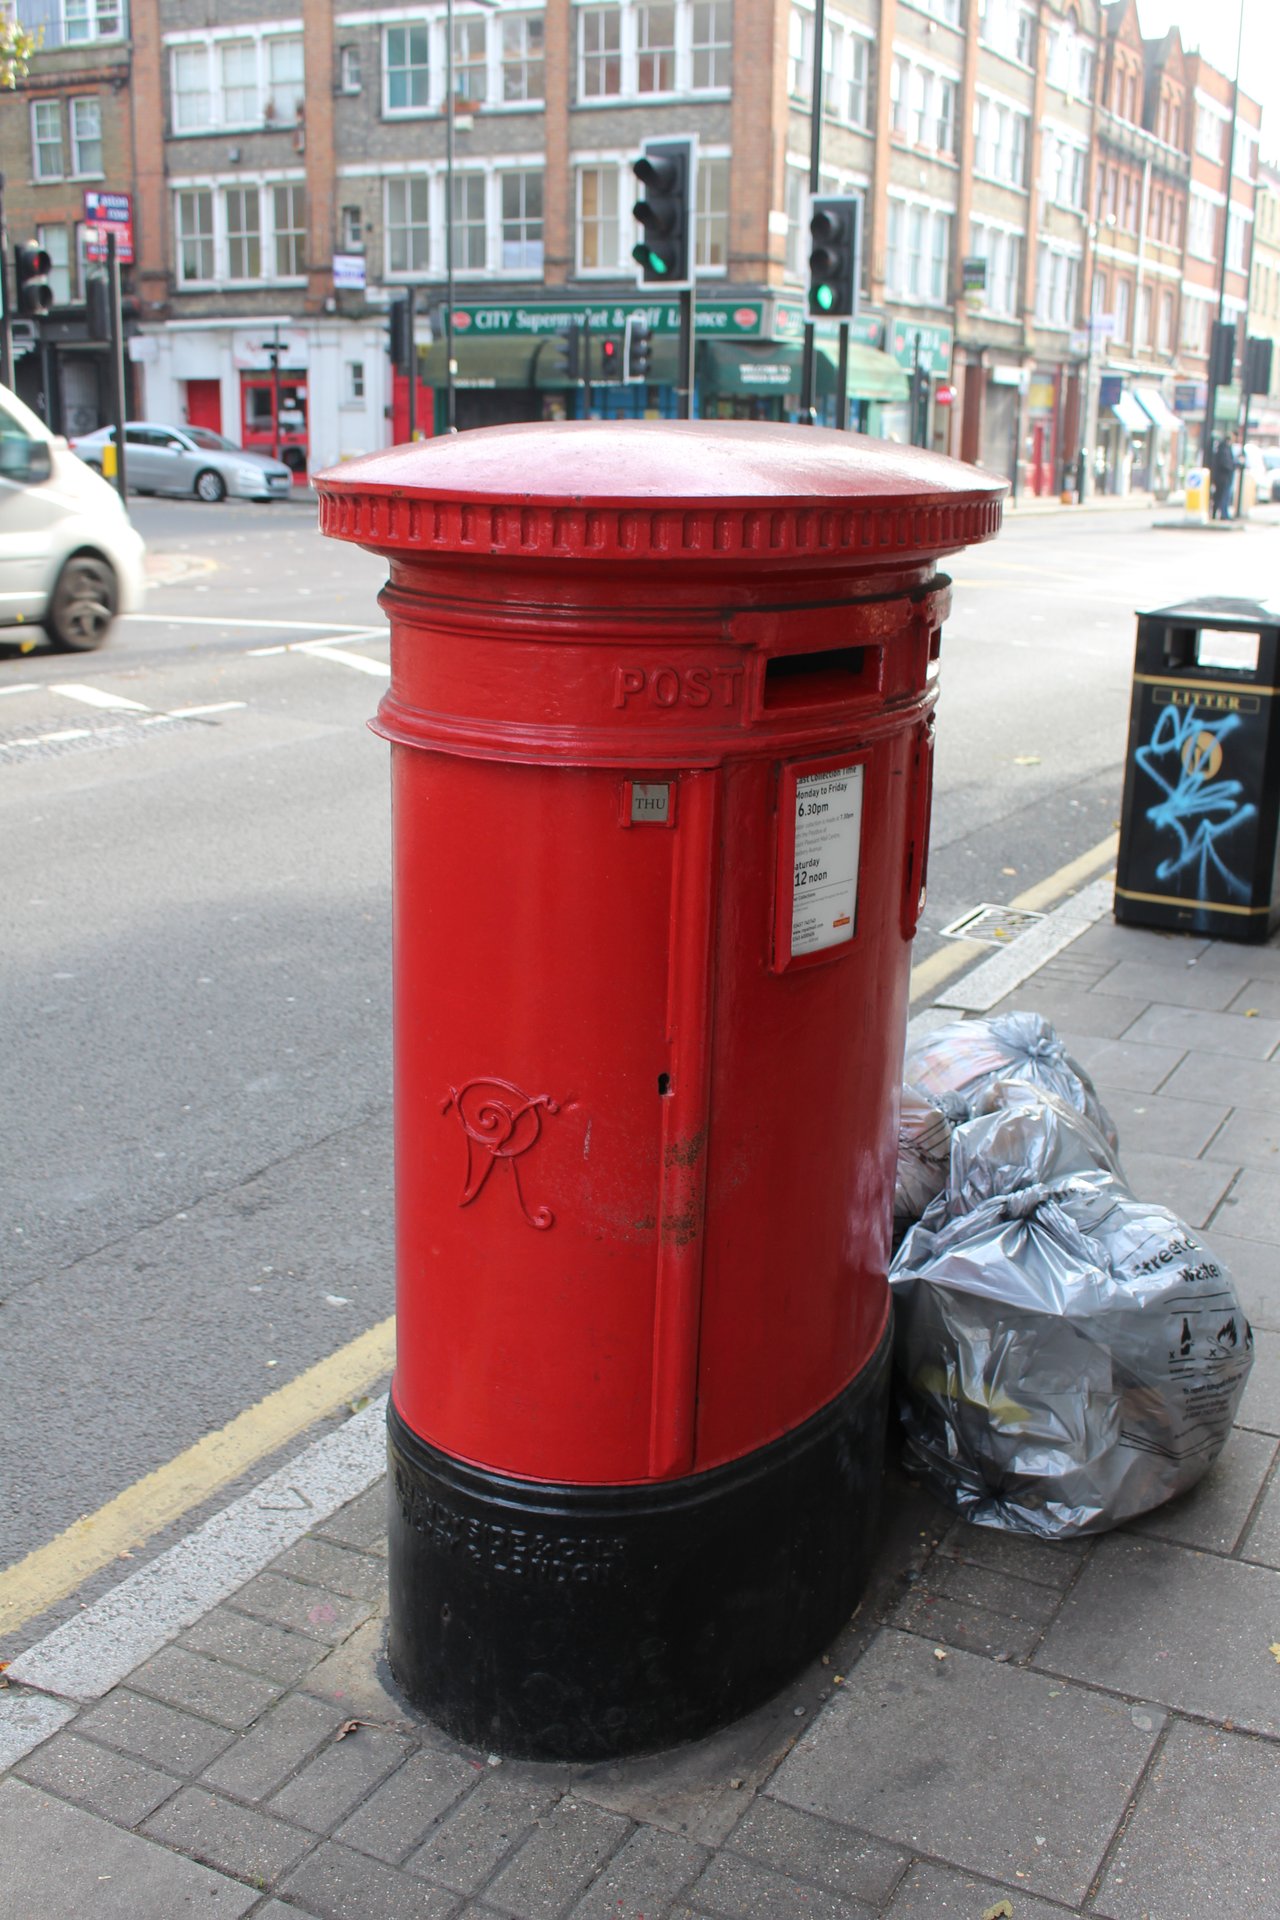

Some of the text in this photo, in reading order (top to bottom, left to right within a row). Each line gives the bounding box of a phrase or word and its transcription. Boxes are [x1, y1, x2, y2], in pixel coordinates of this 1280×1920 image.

[475, 309, 512, 329] CITY
[612, 308, 625, 328] &
[612, 664, 743, 710] POST
[1171, 687, 1241, 711] LITTER
[796, 774, 810, 785] ast
[821, 786, 828, 795] to
[828, 783, 848, 793] Friday
[635, 797, 666, 810] THU
[798, 803, 829, 817] 6.30pm
[795, 858, 820, 871] aturday
[794, 871, 828, 888] 12 noon
